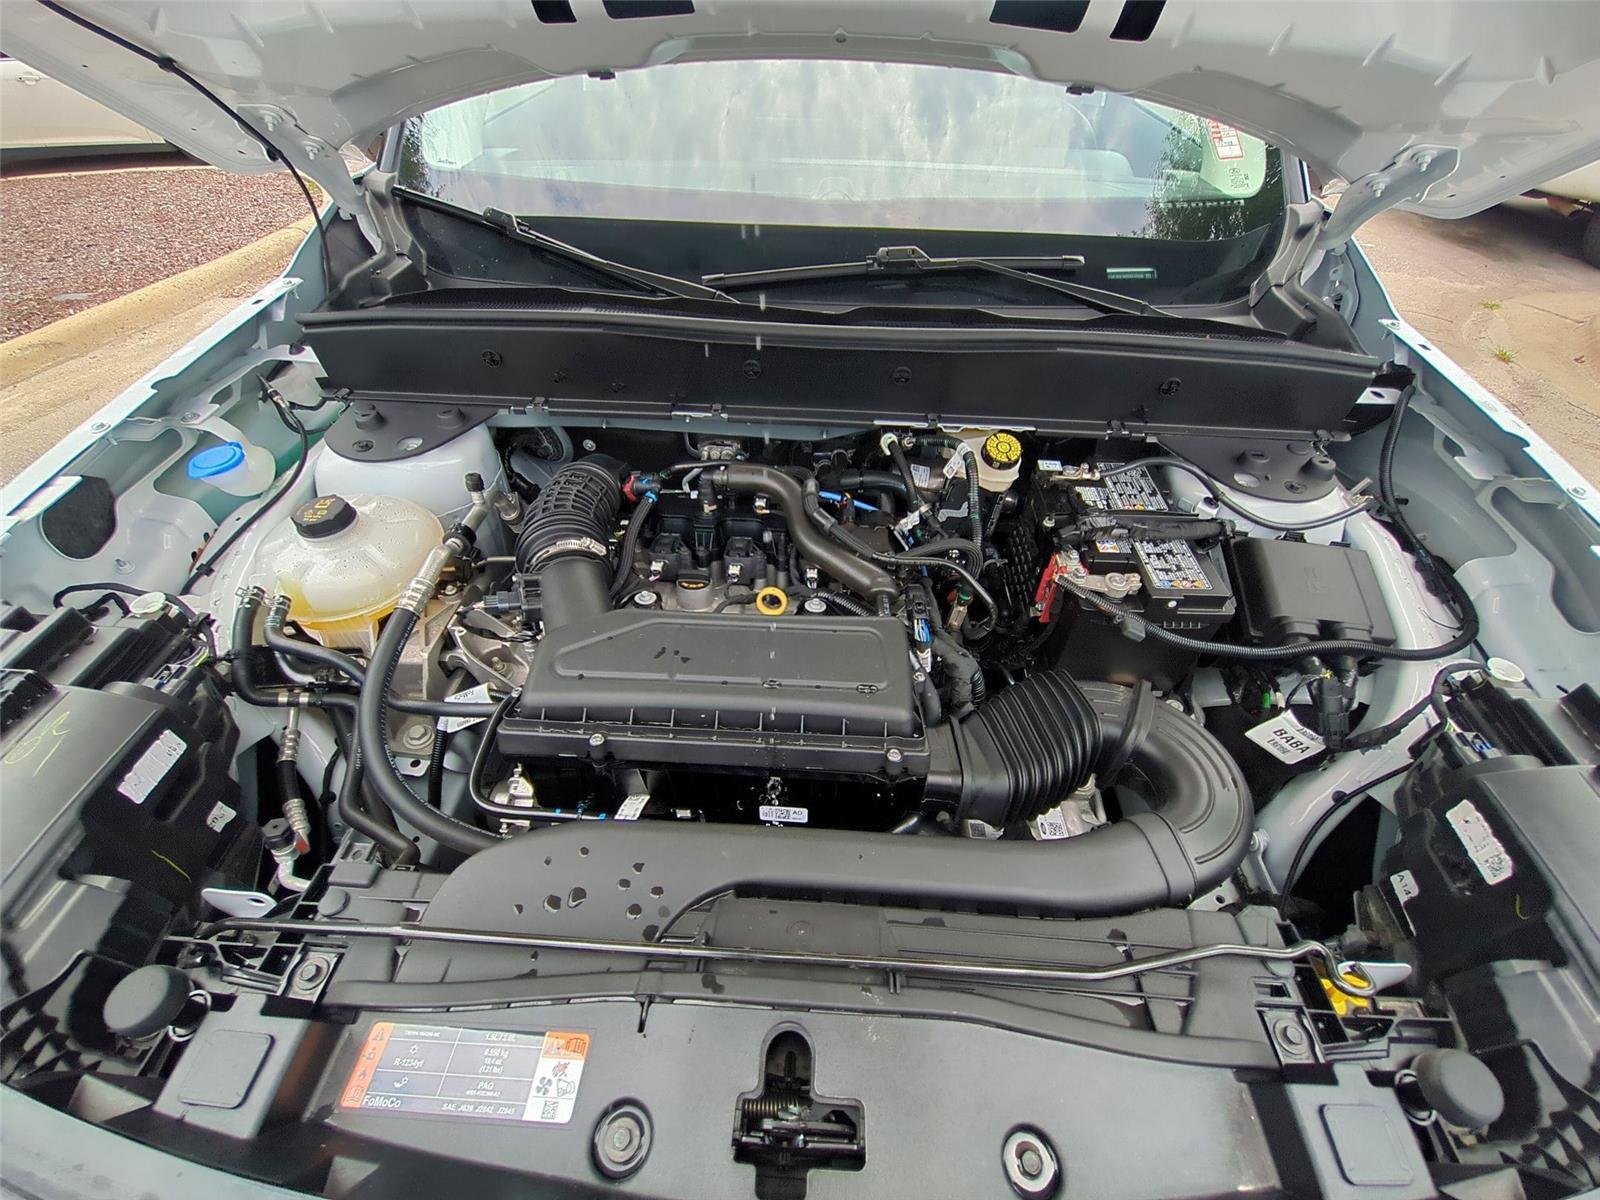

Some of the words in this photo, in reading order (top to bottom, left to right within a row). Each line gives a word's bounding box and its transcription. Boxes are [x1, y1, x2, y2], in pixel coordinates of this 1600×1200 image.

[1273, 728, 1310, 754] BABA
[392, 1058, 424, 1069] R-1234yf
[362, 1095, 401, 1107] FoMoCo
[441, 1103, 457, 1111] SAE
